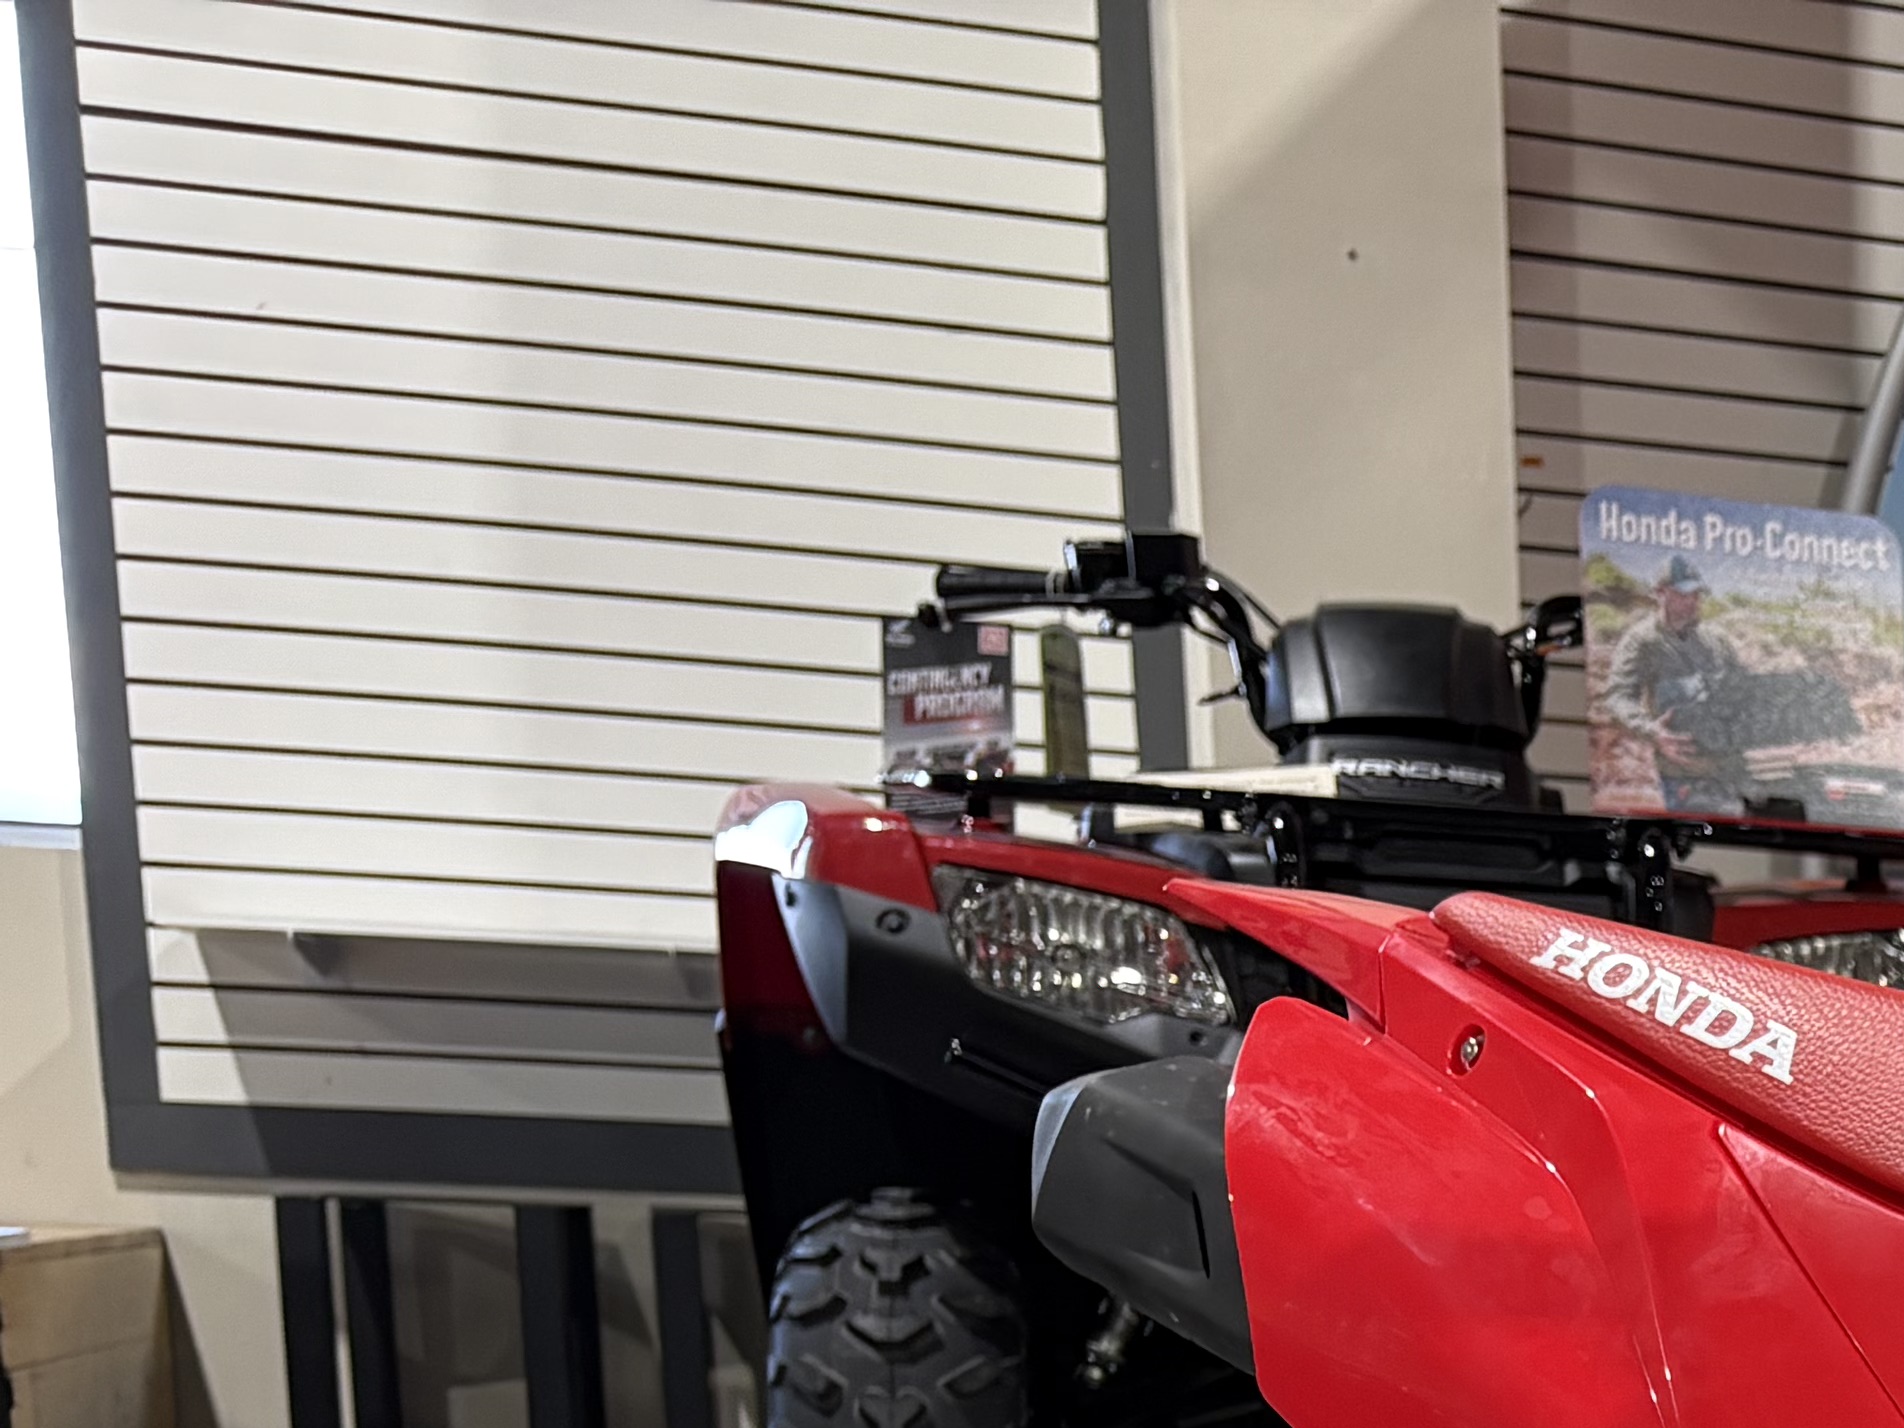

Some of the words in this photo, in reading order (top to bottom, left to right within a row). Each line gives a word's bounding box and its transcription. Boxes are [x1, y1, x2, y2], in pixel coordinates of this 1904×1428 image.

[1599, 500, 1698, 549] Honda
[1703, 512, 1890, 571] Pro-Connect
[914, 684, 1005, 719] PROGRAM
[1332, 757, 1506, 791] RANCHER
[1529, 928, 1799, 1086] HONDA
